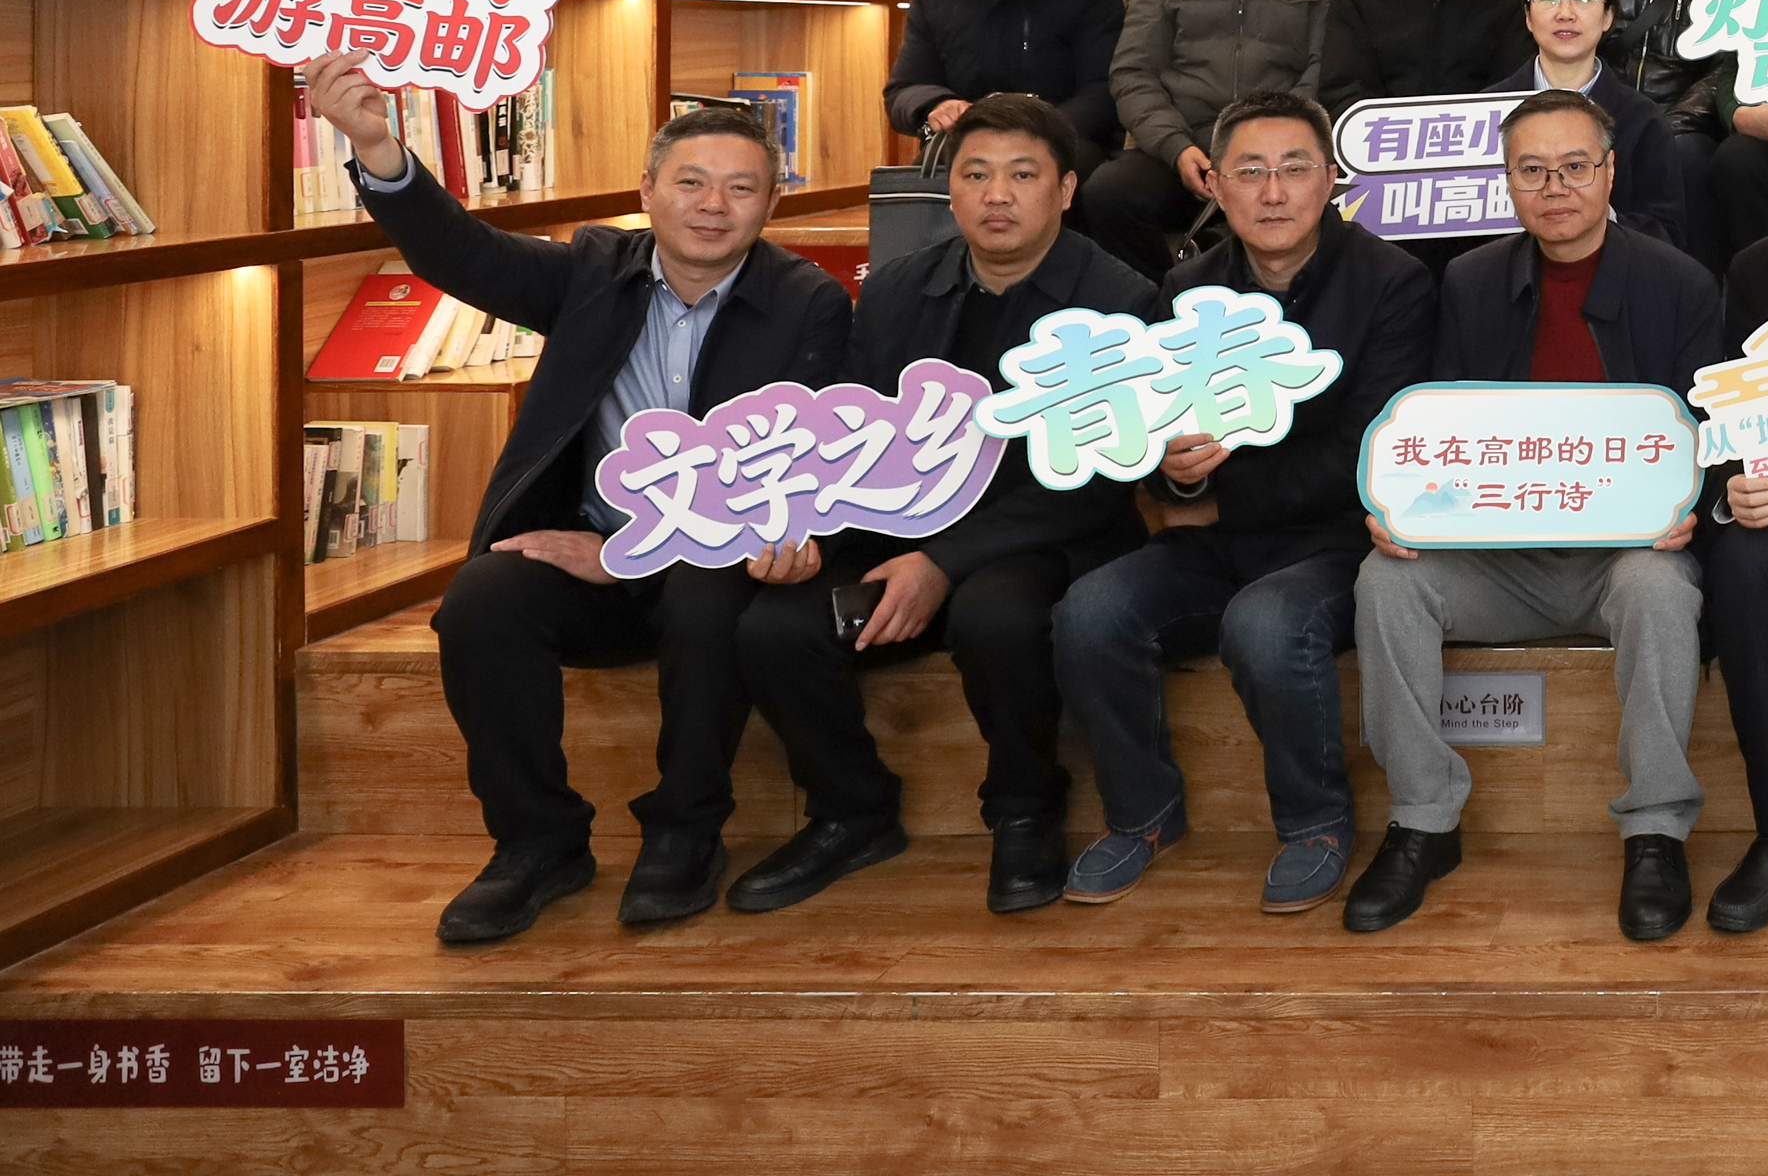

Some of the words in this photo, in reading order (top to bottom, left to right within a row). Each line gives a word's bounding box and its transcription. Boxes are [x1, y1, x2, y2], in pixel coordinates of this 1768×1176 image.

[996, 299, 1326, 475] 青春
[1391, 432, 1677, 469] 我在高邮的日子
[620, 380, 987, 559] 文学之乡
[1453, 476, 1614, 513] “三行诗”
[1440, 693, 1524, 715] 小心台阶
[1441, 719, 1468, 728] Mind
[1472, 719, 1489, 728] the
[1494, 719, 1519, 730] Step
[0, 1043, 170, 1085] 带走一身书香
[198, 1044, 370, 1085] 留下一室洁净
